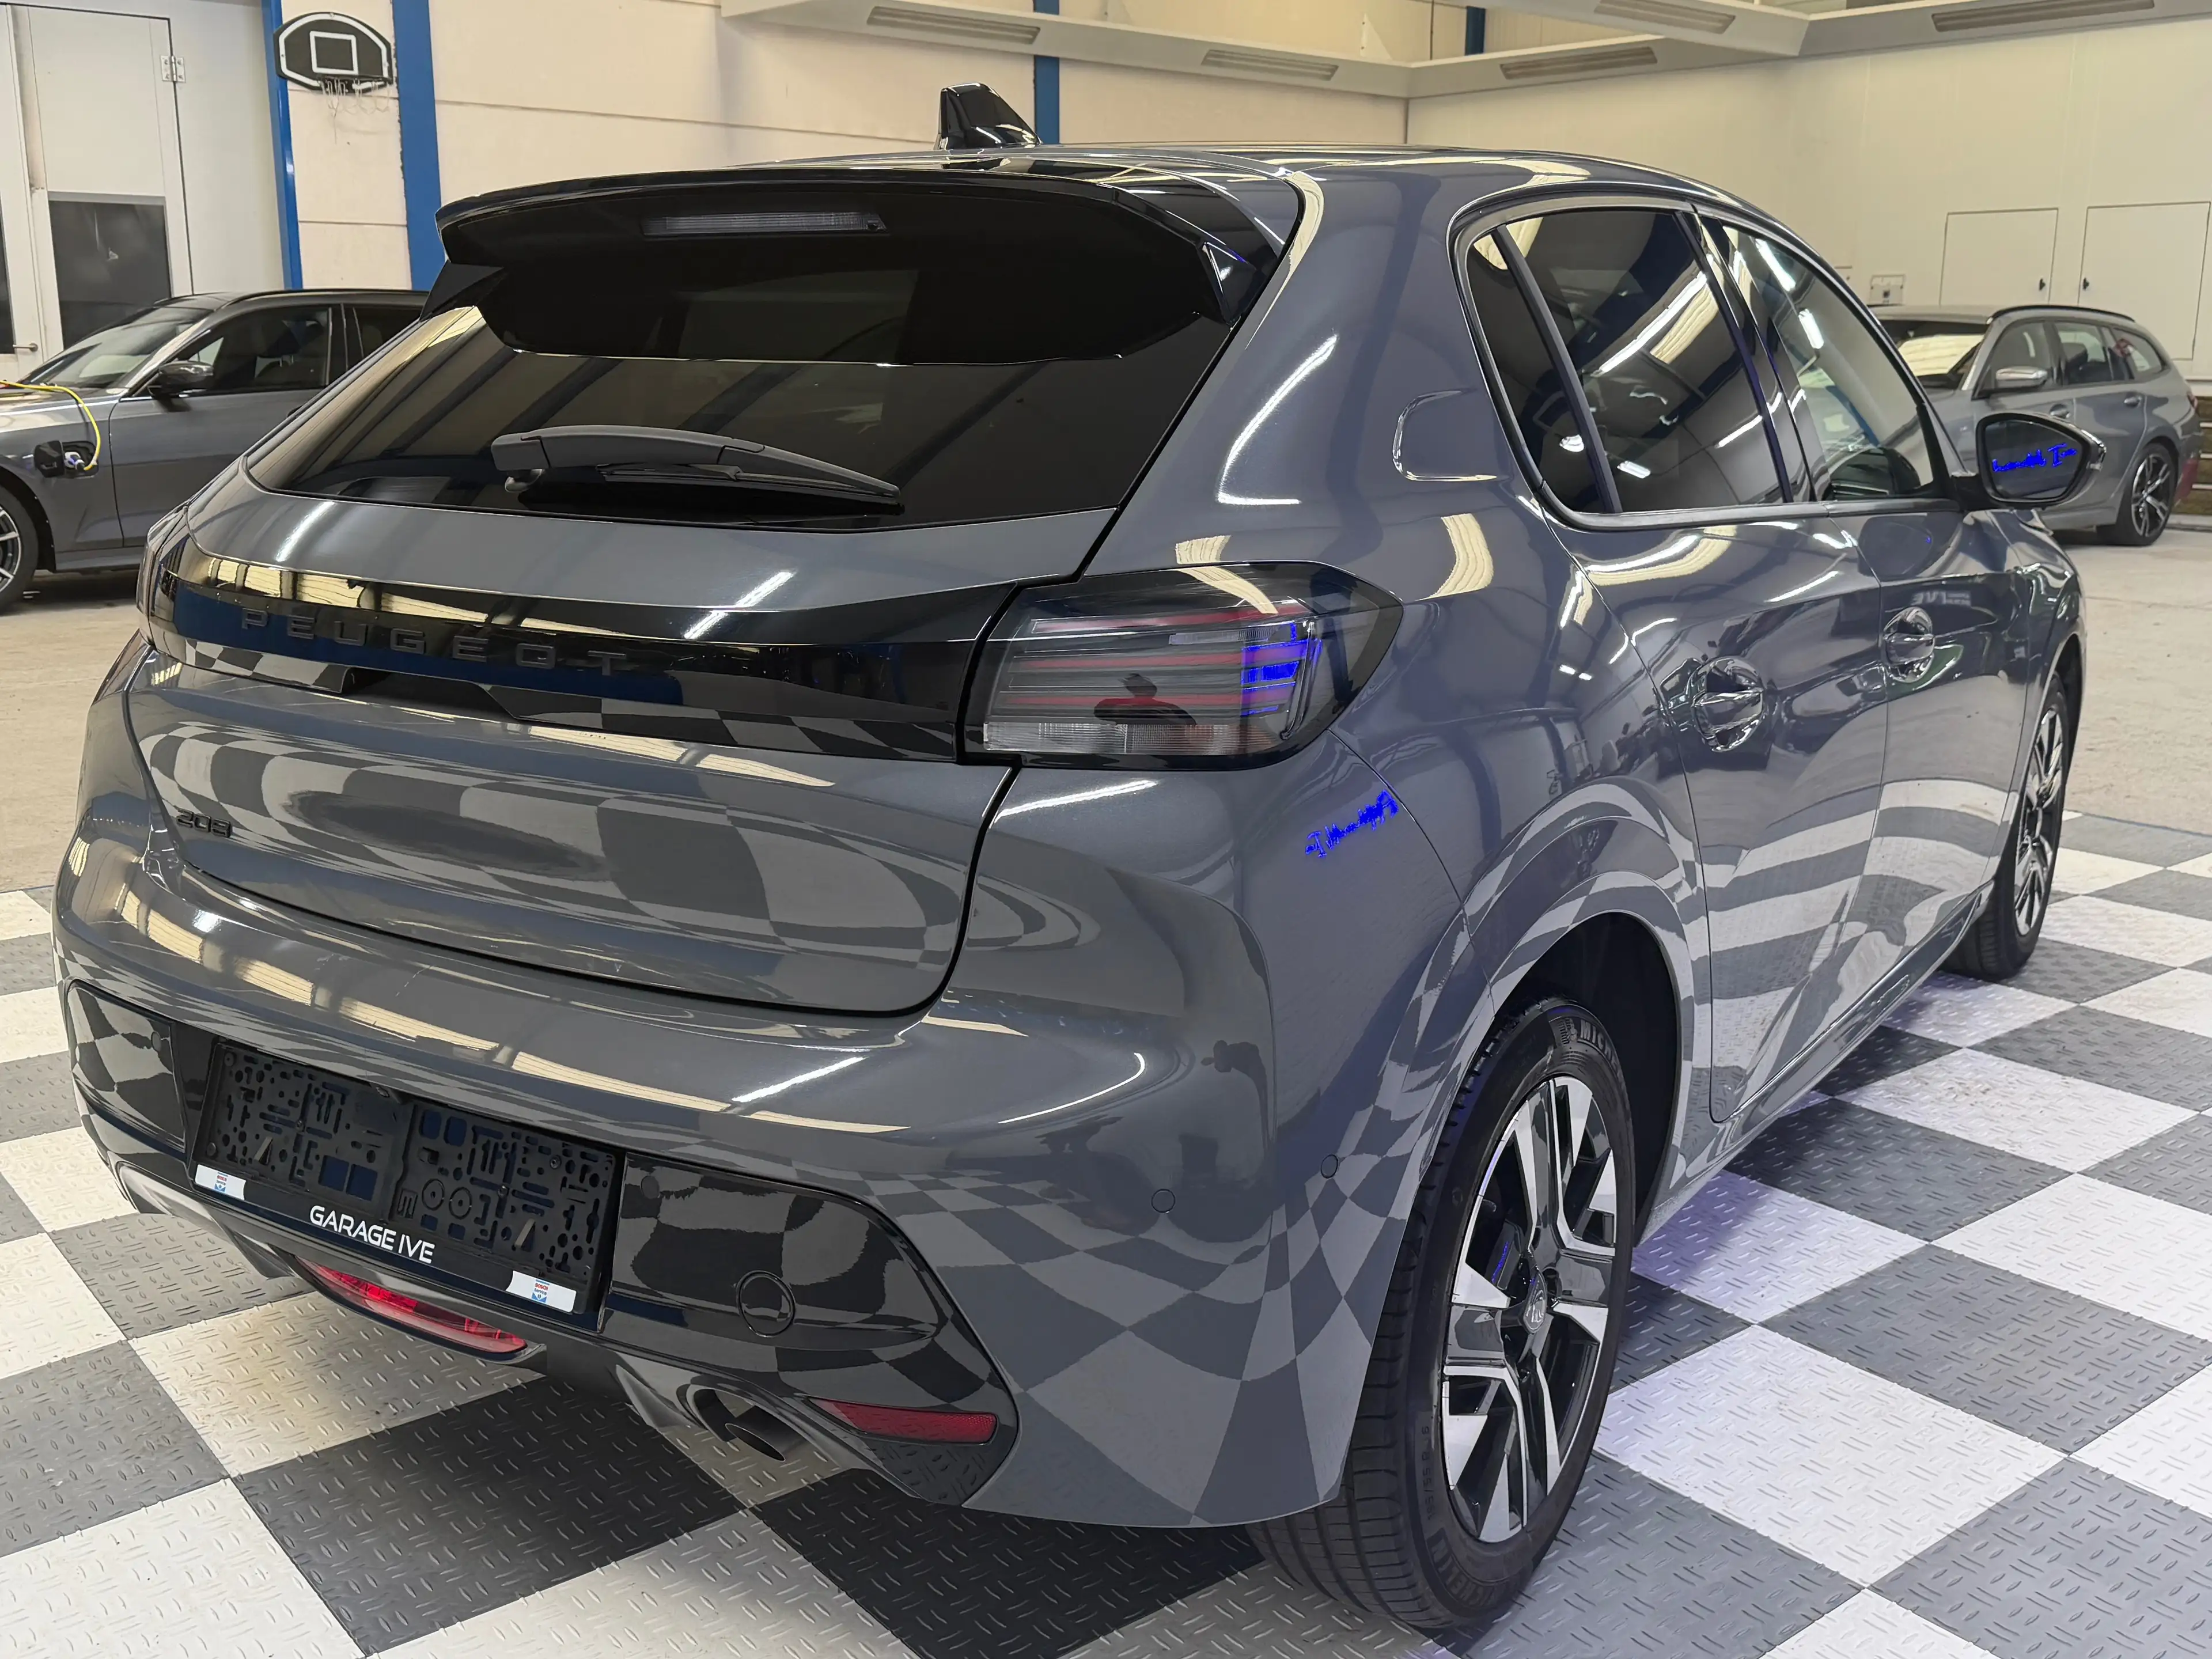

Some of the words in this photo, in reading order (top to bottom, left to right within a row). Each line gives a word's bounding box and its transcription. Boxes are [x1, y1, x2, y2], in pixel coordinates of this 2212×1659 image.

[241, 607, 627, 676] PEUGEOT
[175, 807, 233, 838] 208
[310, 1205, 397, 1251] GARAGE
[397, 1233, 435, 1264] IVE
